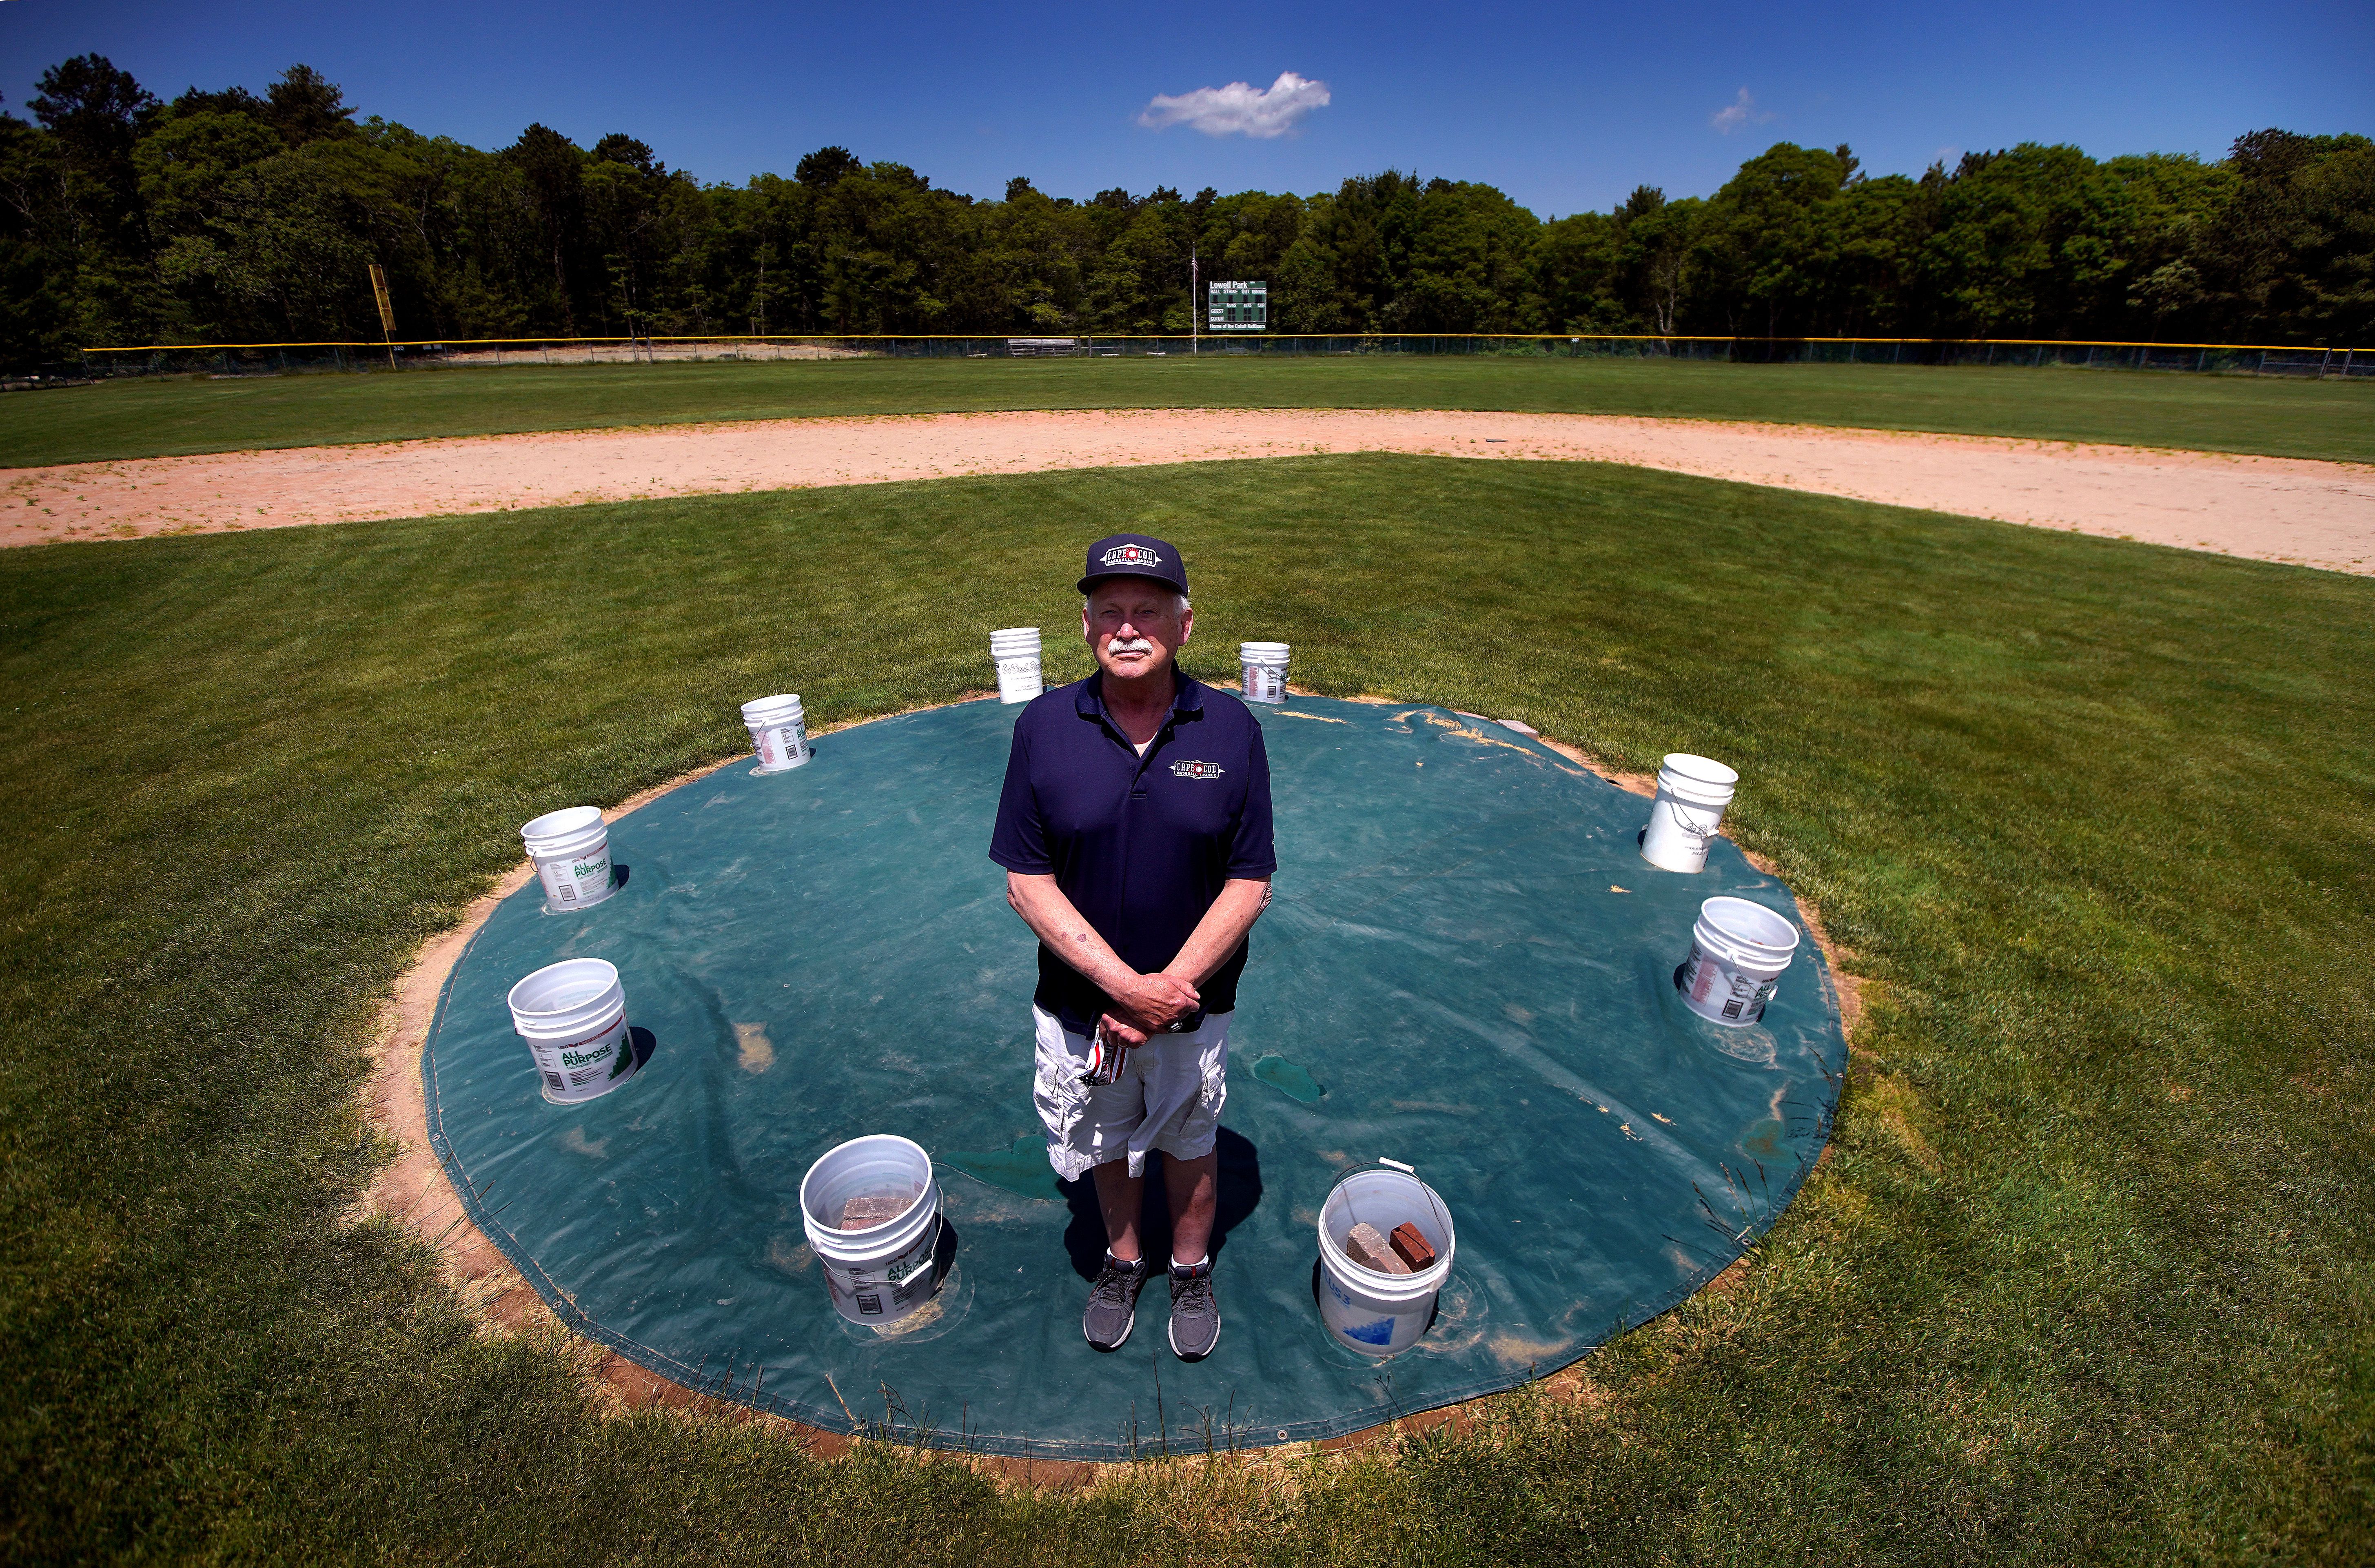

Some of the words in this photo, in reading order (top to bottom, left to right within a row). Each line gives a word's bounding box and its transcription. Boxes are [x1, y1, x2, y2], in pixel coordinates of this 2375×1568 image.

[1107, 549, 1127, 560] CAPE
[1138, 550, 1153, 560] COD
[1002, 664, 1011, 674] On
[1011, 663, 1029, 674] Deck
[1177, 763, 1194, 772] CAPE
[1203, 765, 1216, 773] COD
[574, 863, 589, 872] ALL
[575, 858, 606, 877] PURPOSE
[563, 1043, 612, 1066] PURPOSE
[563, 1051, 582, 1060] ALL
[888, 1261, 910, 1277] ALL
